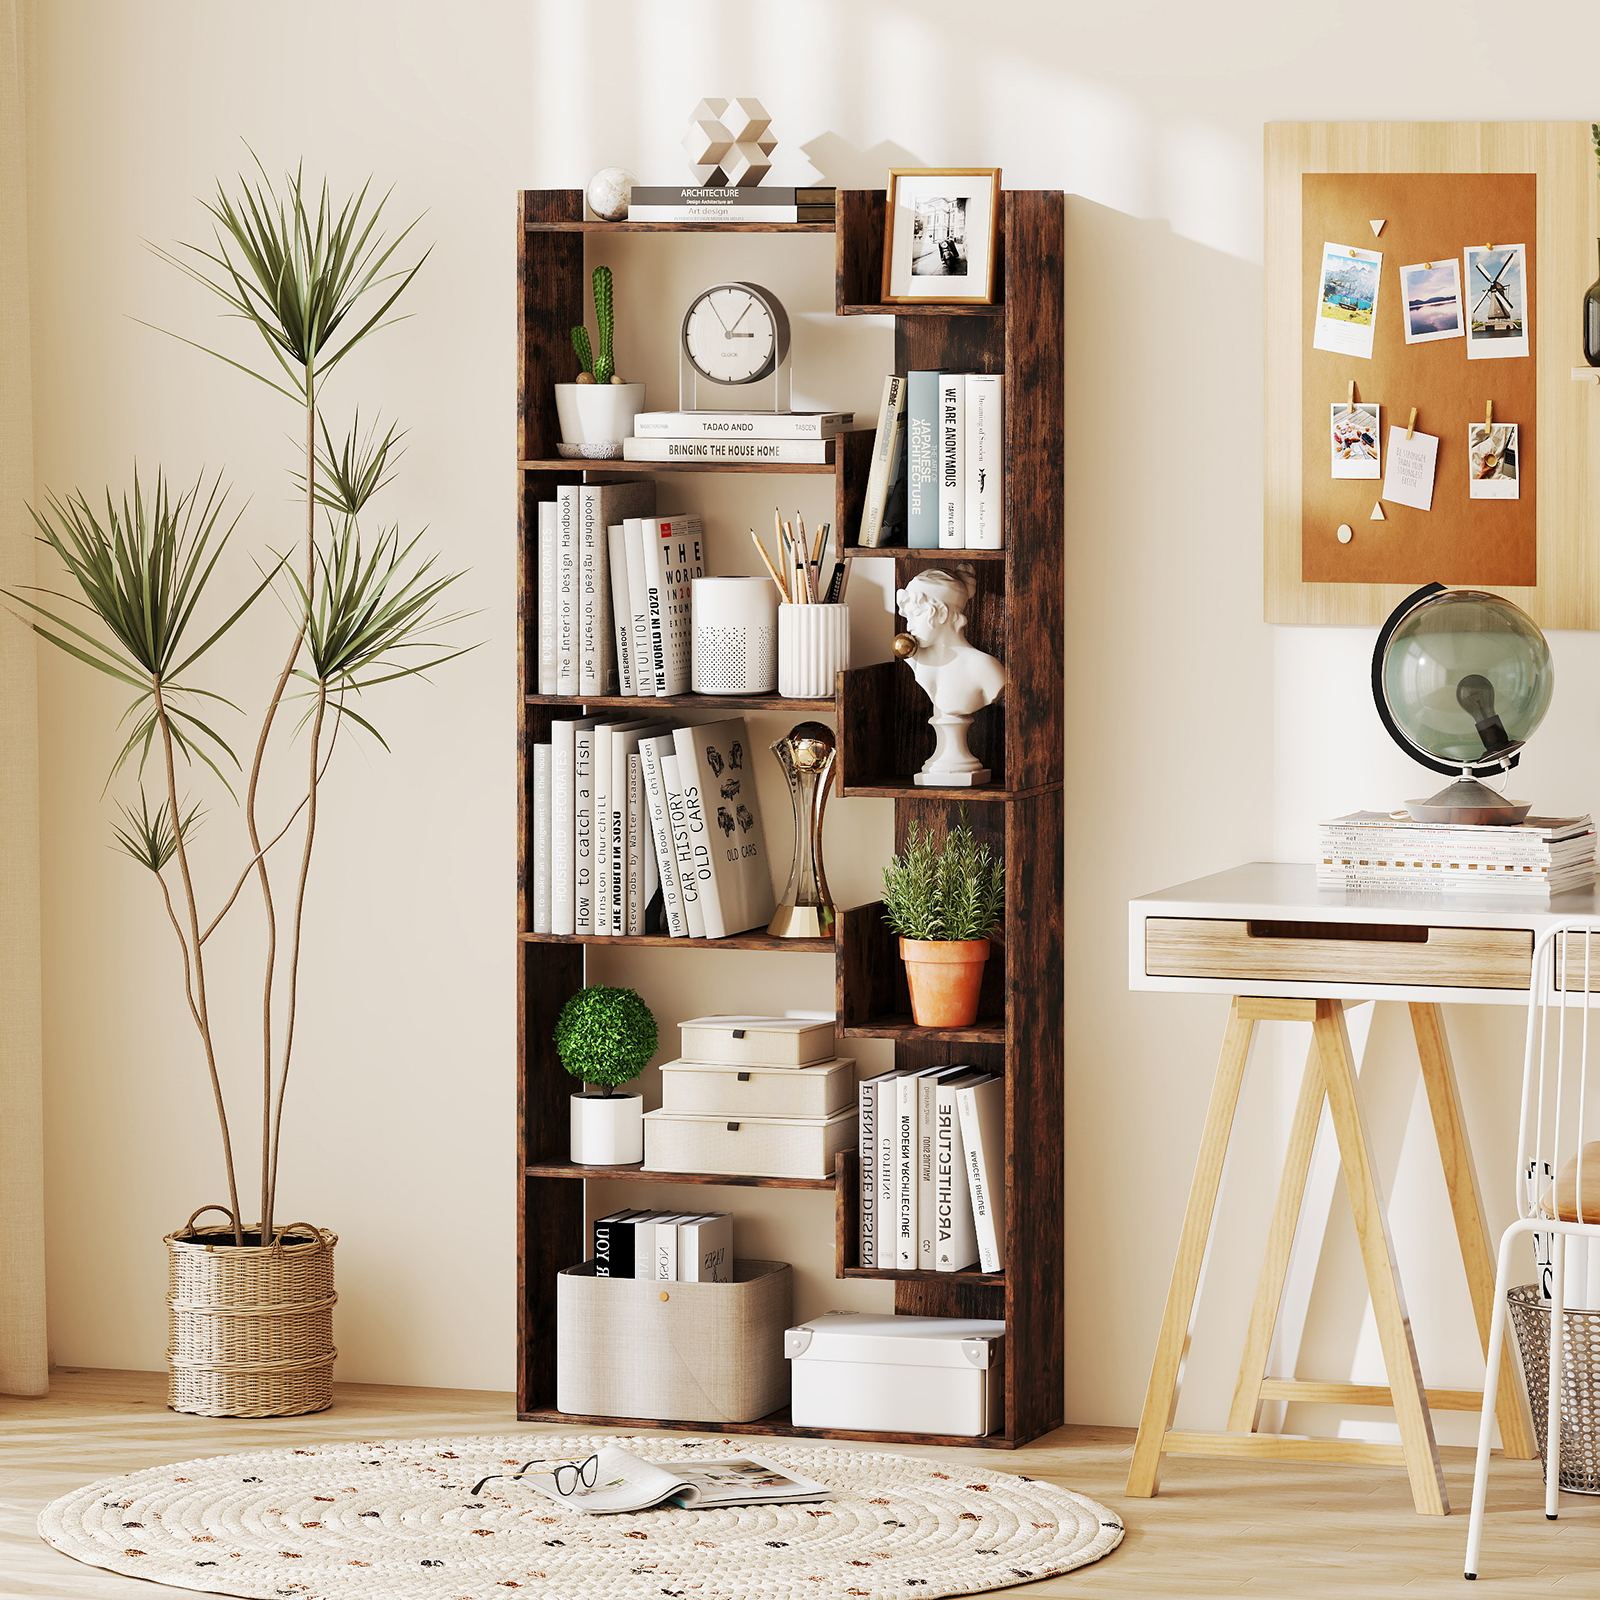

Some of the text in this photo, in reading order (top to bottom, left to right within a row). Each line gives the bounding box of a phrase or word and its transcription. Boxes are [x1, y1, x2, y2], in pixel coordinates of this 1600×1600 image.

[680, 189, 740, 198] ARCHITECTURE
[688, 207, 729, 216] Art design
[668, 444, 780, 457] BRINGING THE HOUSE HOME
[702, 422, 754, 432] TADAO ANDO
[921, 418, 932, 483] JAPANESE
[945, 387, 957, 488] WE ARE ANONYMOUS
[977, 395, 986, 427] Dreaming
[911, 418, 921, 515] ARCHITECTURE
[542, 528, 552, 665] HOUSEHOLD DECORATES
[561, 494, 573, 678] The Interior Design Handbook
[663, 541, 701, 566] THE
[665, 566, 703, 585] WORLD
[634, 614, 651, 691] INTUITION
[648, 587, 666, 692] THE WORLD IN 2020
[668, 603, 692, 616] TRUM
[556, 750, 567, 902] HOUSEHOLD DECORATES
[576, 740, 590, 927] How to catch a fish
[598, 794, 606, 927] Winston Churchill
[629, 756, 639, 932] Steve Jobs by Walter Isaacson
[644, 743, 682, 932] HOW TO DRAW Book for children
[668, 792, 698, 903] CAR HISTORY
[685, 786, 712, 880] OLD CARS
[726, 843, 758, 862] OLD CARS
